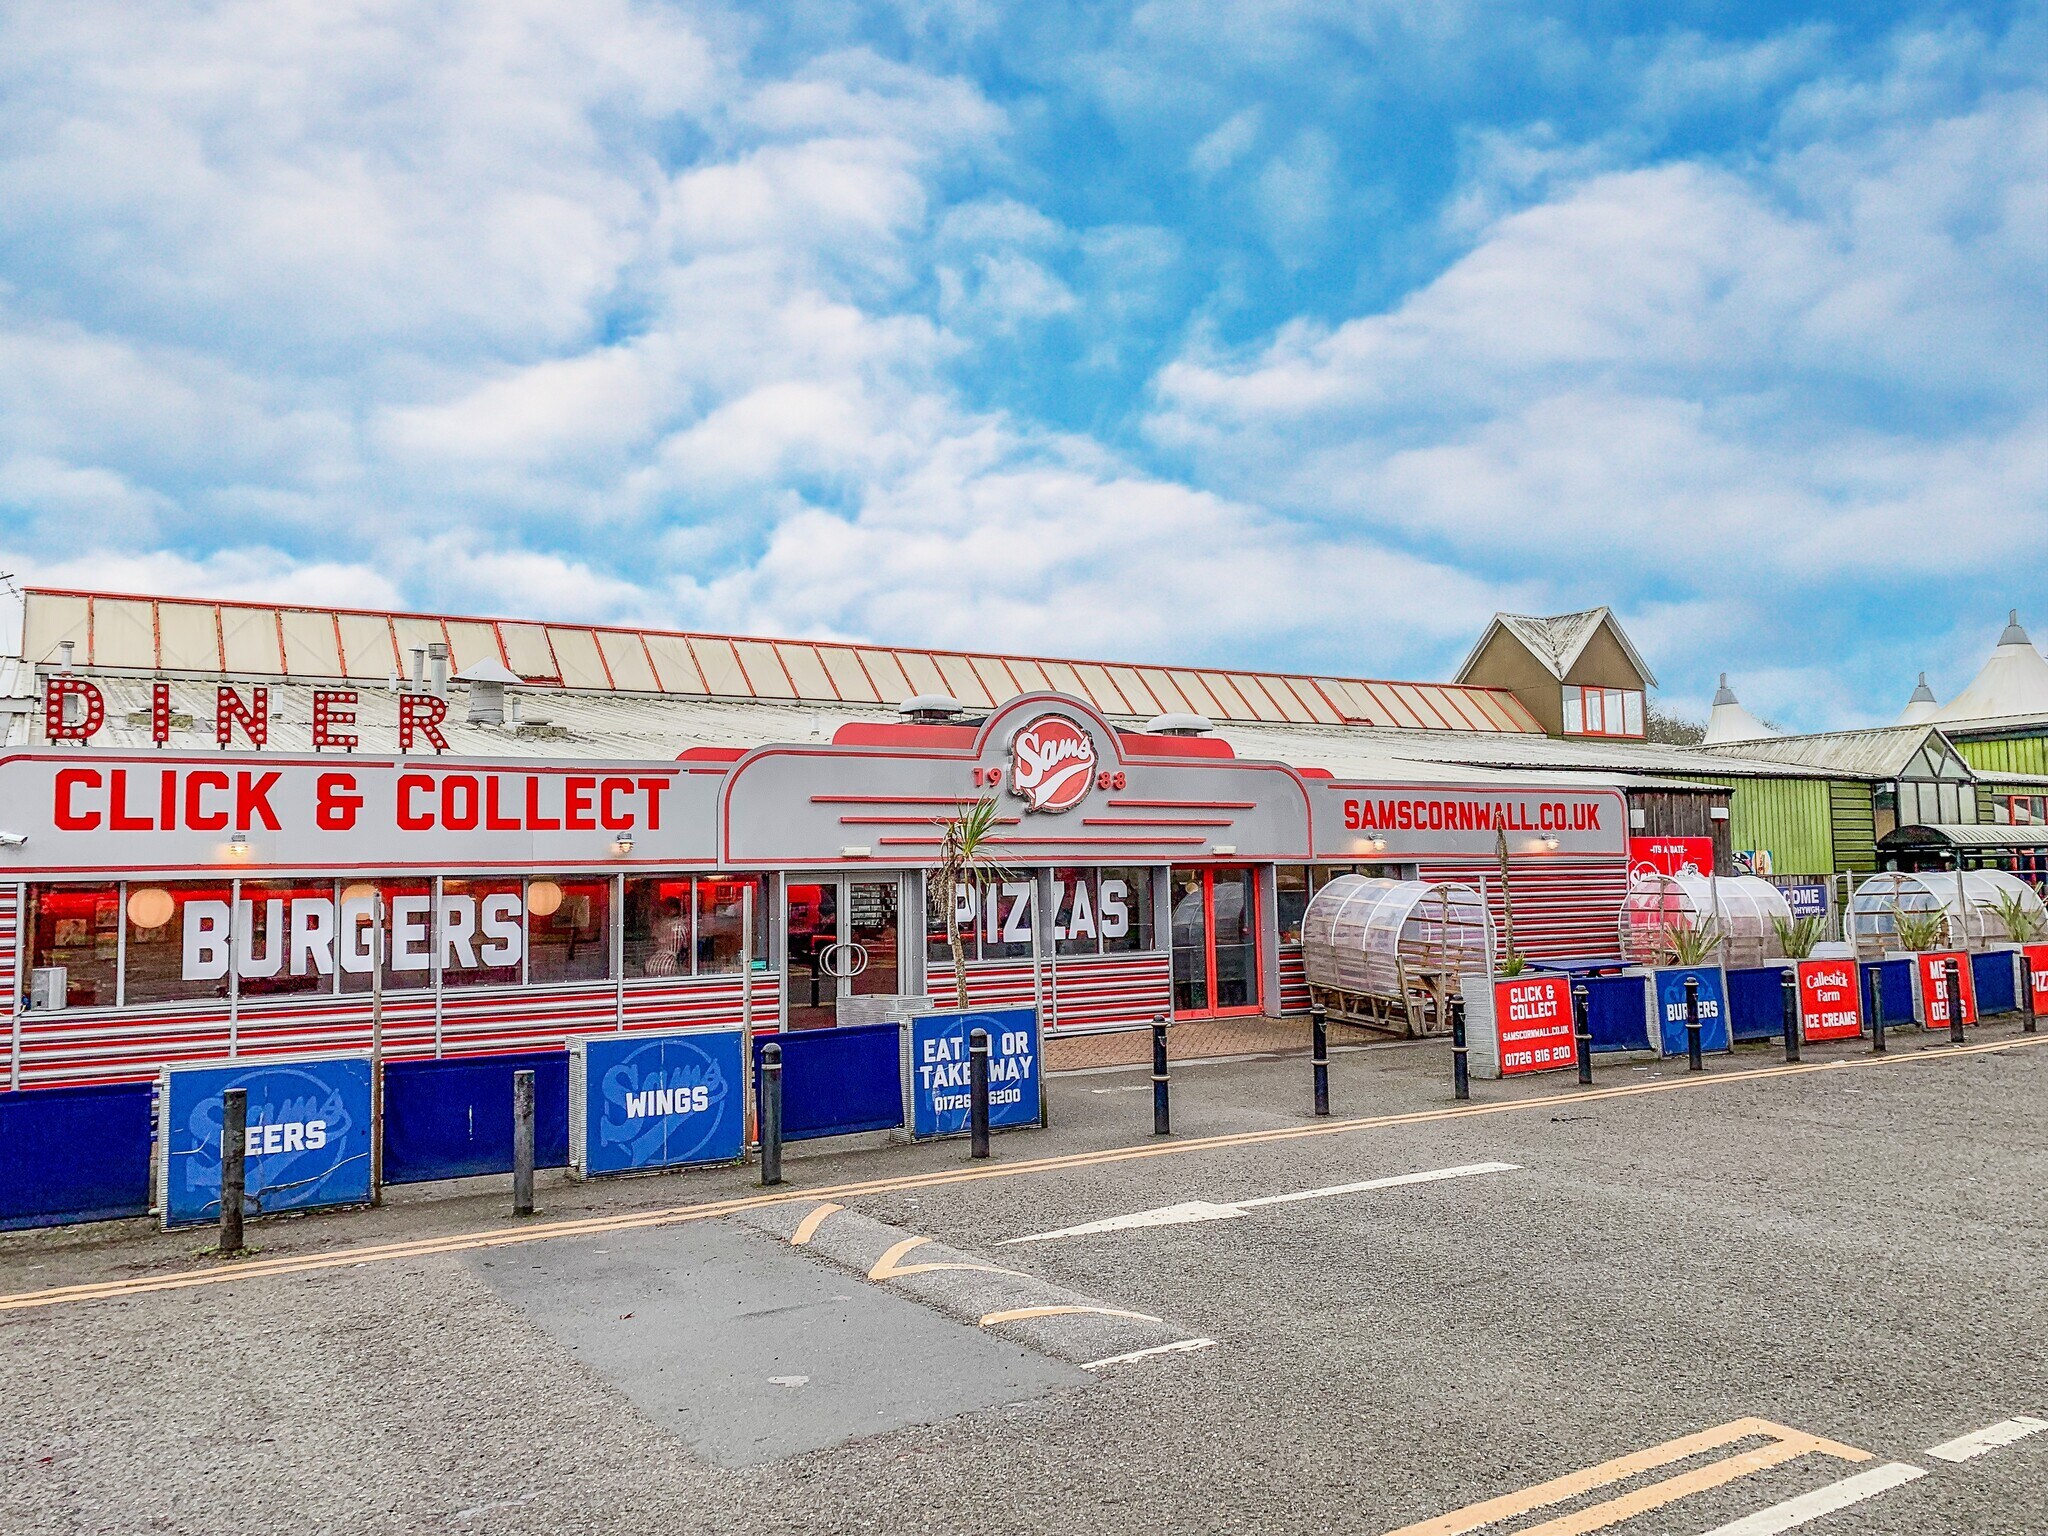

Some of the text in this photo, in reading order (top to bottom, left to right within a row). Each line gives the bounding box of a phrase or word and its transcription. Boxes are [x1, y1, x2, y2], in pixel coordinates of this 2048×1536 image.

[46, 679, 450, 750] DINER
[1016, 732, 1091, 790] Sams
[54, 769, 670, 831] CLICK & COLLECT
[1344, 799, 1601, 831] SAMSCORNWALL.CO.UK
[182, 893, 522, 980] BURGERS
[1510, 984, 1554, 1004] CLICK &
[1807, 971, 1848, 988] Callestick
[1817, 989, 1840, 1002] Farm
[1510, 1001, 1557, 1021] COLLECT
[1666, 1000, 1719, 1021] BURERS
[1805, 1011, 1857, 1028] ICE CREAMS
[923, 1037, 963, 1063] EAT
[1002, 1031, 1029, 1056] OR
[1502, 1025, 1569, 1041] SAMSCORNWALL.CO.UK
[1505, 1045, 1571, 1067] 01726 816 200
[919, 1056, 1033, 1089] TAKEWAY
[626, 1085, 709, 1119] WINGS
[220, 1119, 327, 1158] EERS
